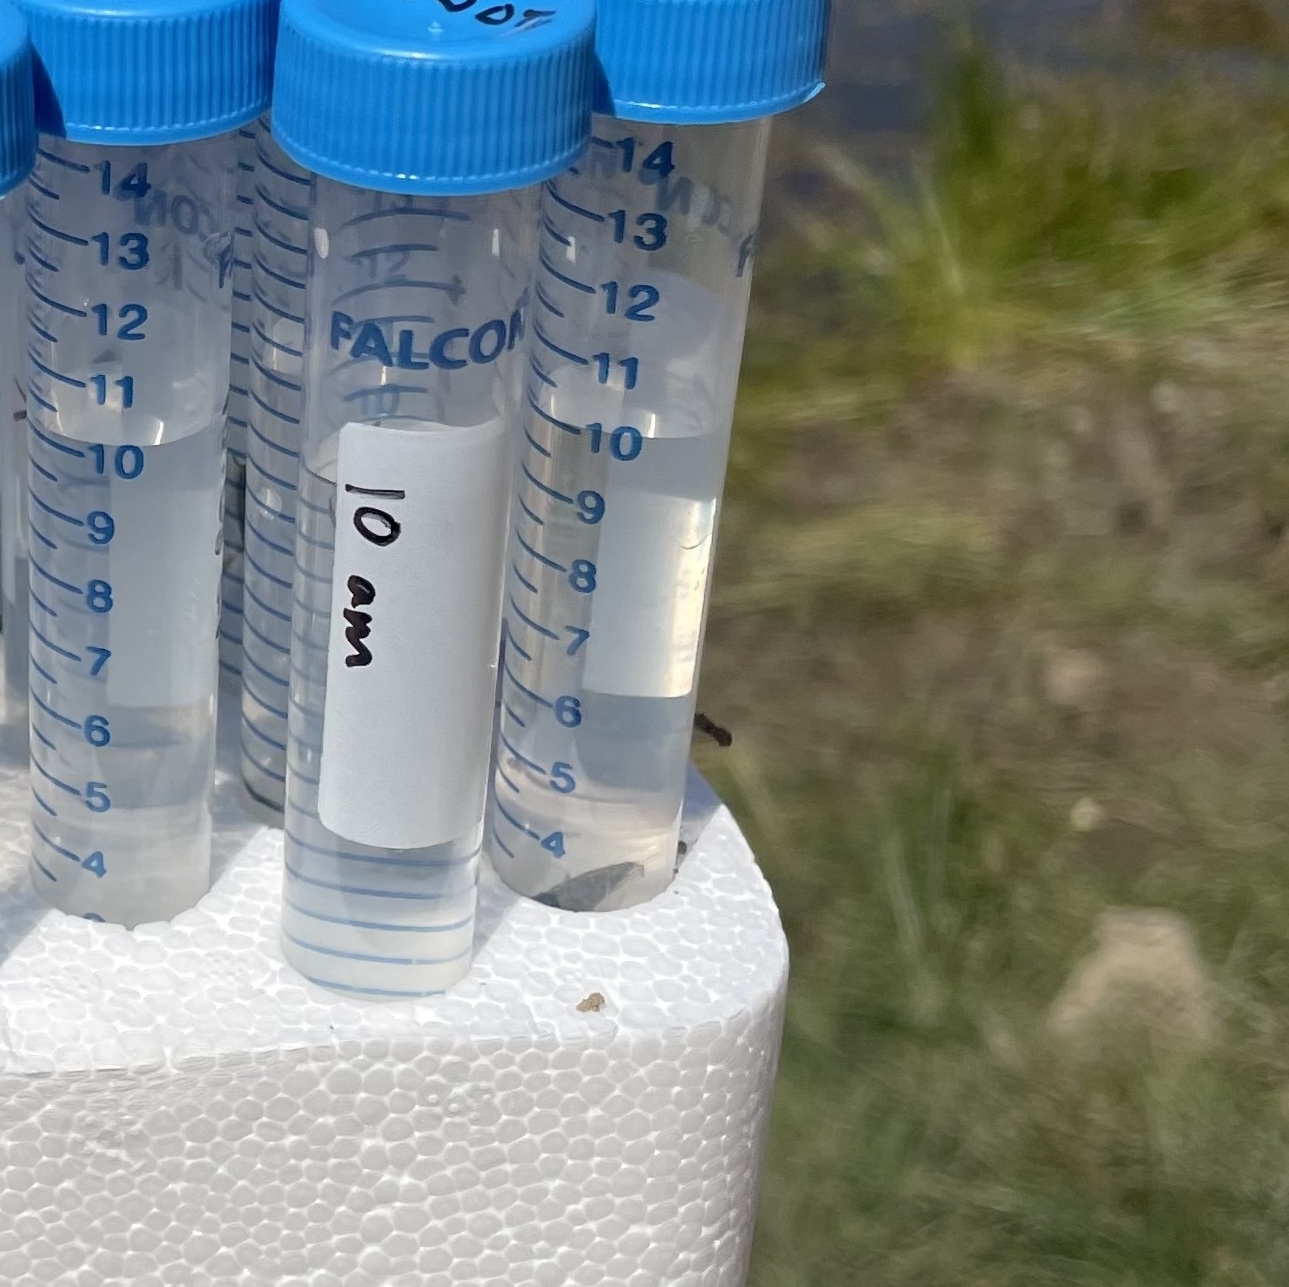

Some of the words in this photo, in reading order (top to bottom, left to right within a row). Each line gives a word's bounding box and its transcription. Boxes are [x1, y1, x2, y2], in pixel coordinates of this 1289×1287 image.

[616, 137, 675, 178] 14
[91, 159, 152, 198] 14
[608, 209, 668, 252] 13
[90, 231, 149, 271] 13
[600, 281, 660, 322] 12
[90, 303, 148, 341] 12
[592, 352, 640, 390] 11
[88, 374, 134, 409] 11
[585, 422, 643, 462] 10
[87, 444, 145, 480] 10
[345, 483, 406, 548] 10
[576, 489, 606, 526] 9
[86, 510, 115, 545] 9
[568, 559, 598, 594] 8
[86, 579, 114, 613] 8
[565, 625, 591, 656] 7
[85, 646, 112, 676] 7
[554, 695, 583, 728] 6
[83, 715, 111, 748] 6
[549, 762, 576, 794] 5
[85, 781, 111, 814] 5
[540, 831, 566, 858] 4
[82, 850, 108, 878] 4
